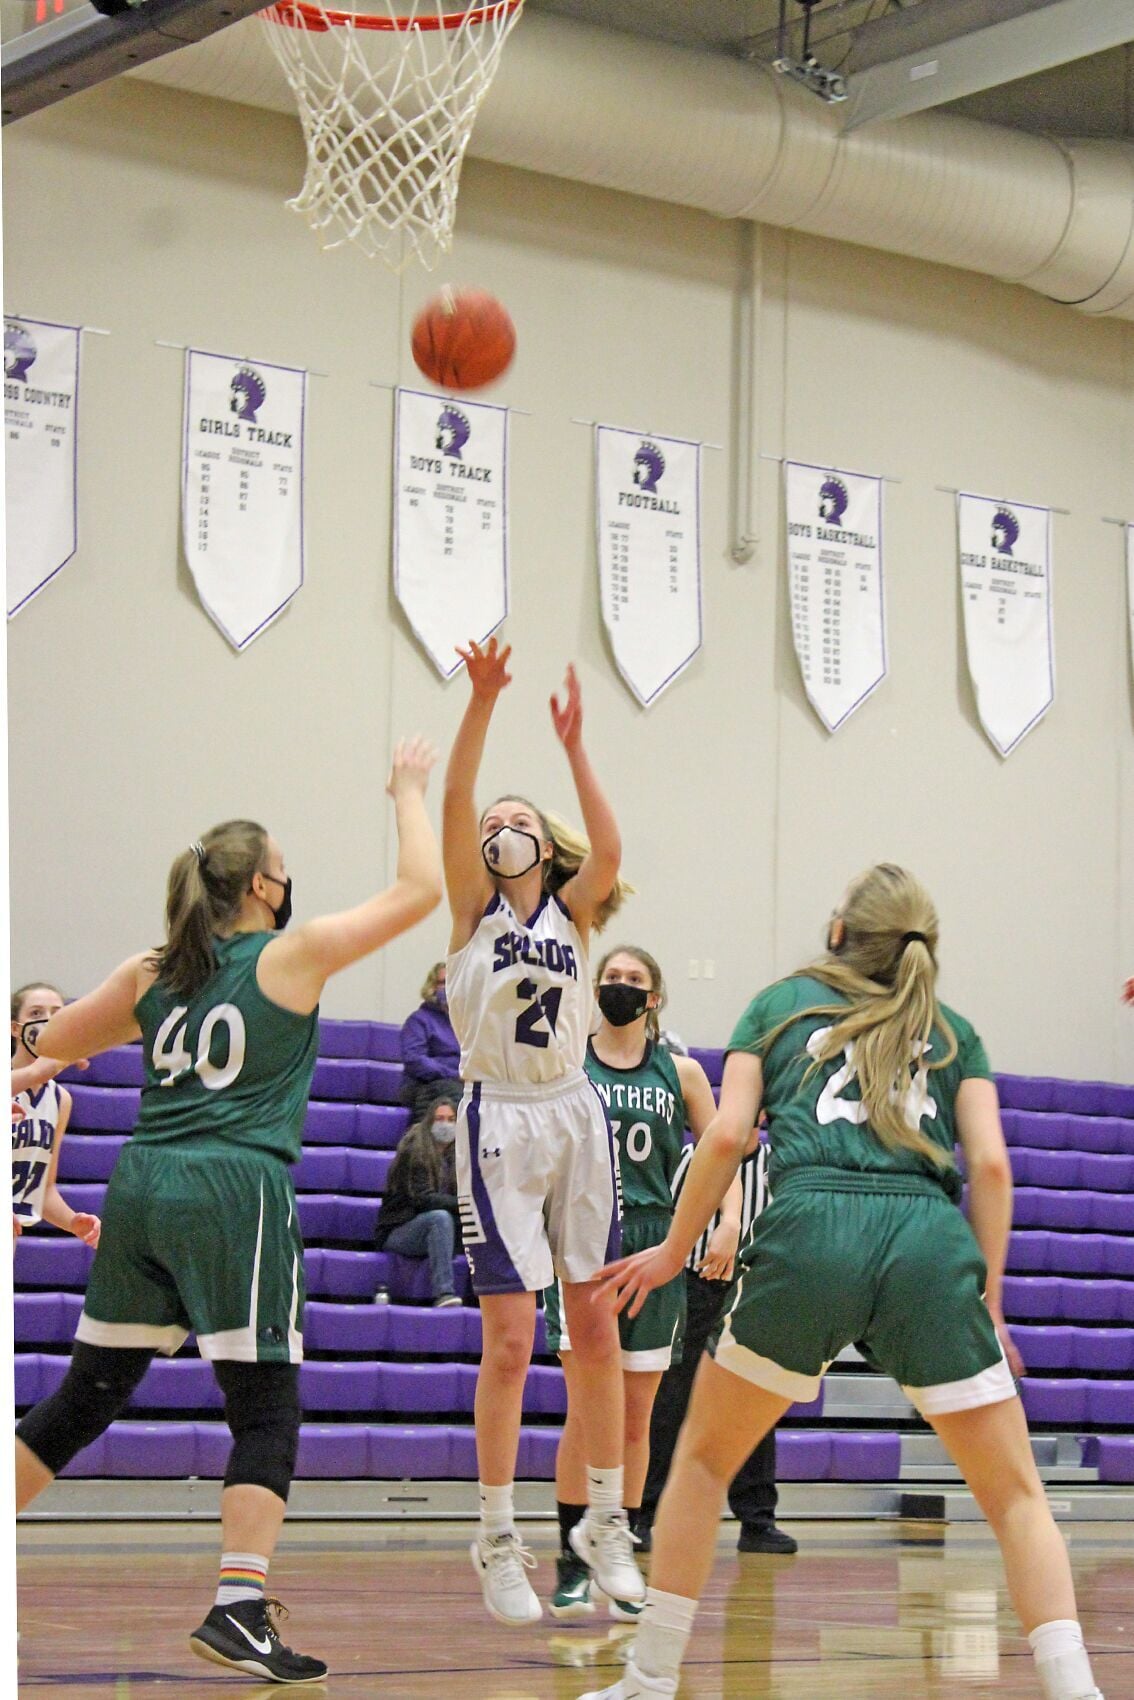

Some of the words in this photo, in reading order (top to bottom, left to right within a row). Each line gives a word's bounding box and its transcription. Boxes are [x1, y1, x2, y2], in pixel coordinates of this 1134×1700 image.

[24, 387, 72, 408] COUNTRY
[199, 418, 241, 438] GIRLS
[247, 427, 292, 448] TRACK
[410, 455, 442, 474] BOYS
[449, 463, 492, 483] TRACK
[617, 492, 681, 515] FOOTBALL
[787, 522, 812, 538] BOYS
[816, 527, 876, 549] BASKETBALL
[960, 552, 986, 568] GIRLS
[991, 557, 1045, 577] BASKETBALL
[515, 977, 563, 1048] 21
[152, 1003, 246, 1091] 40
